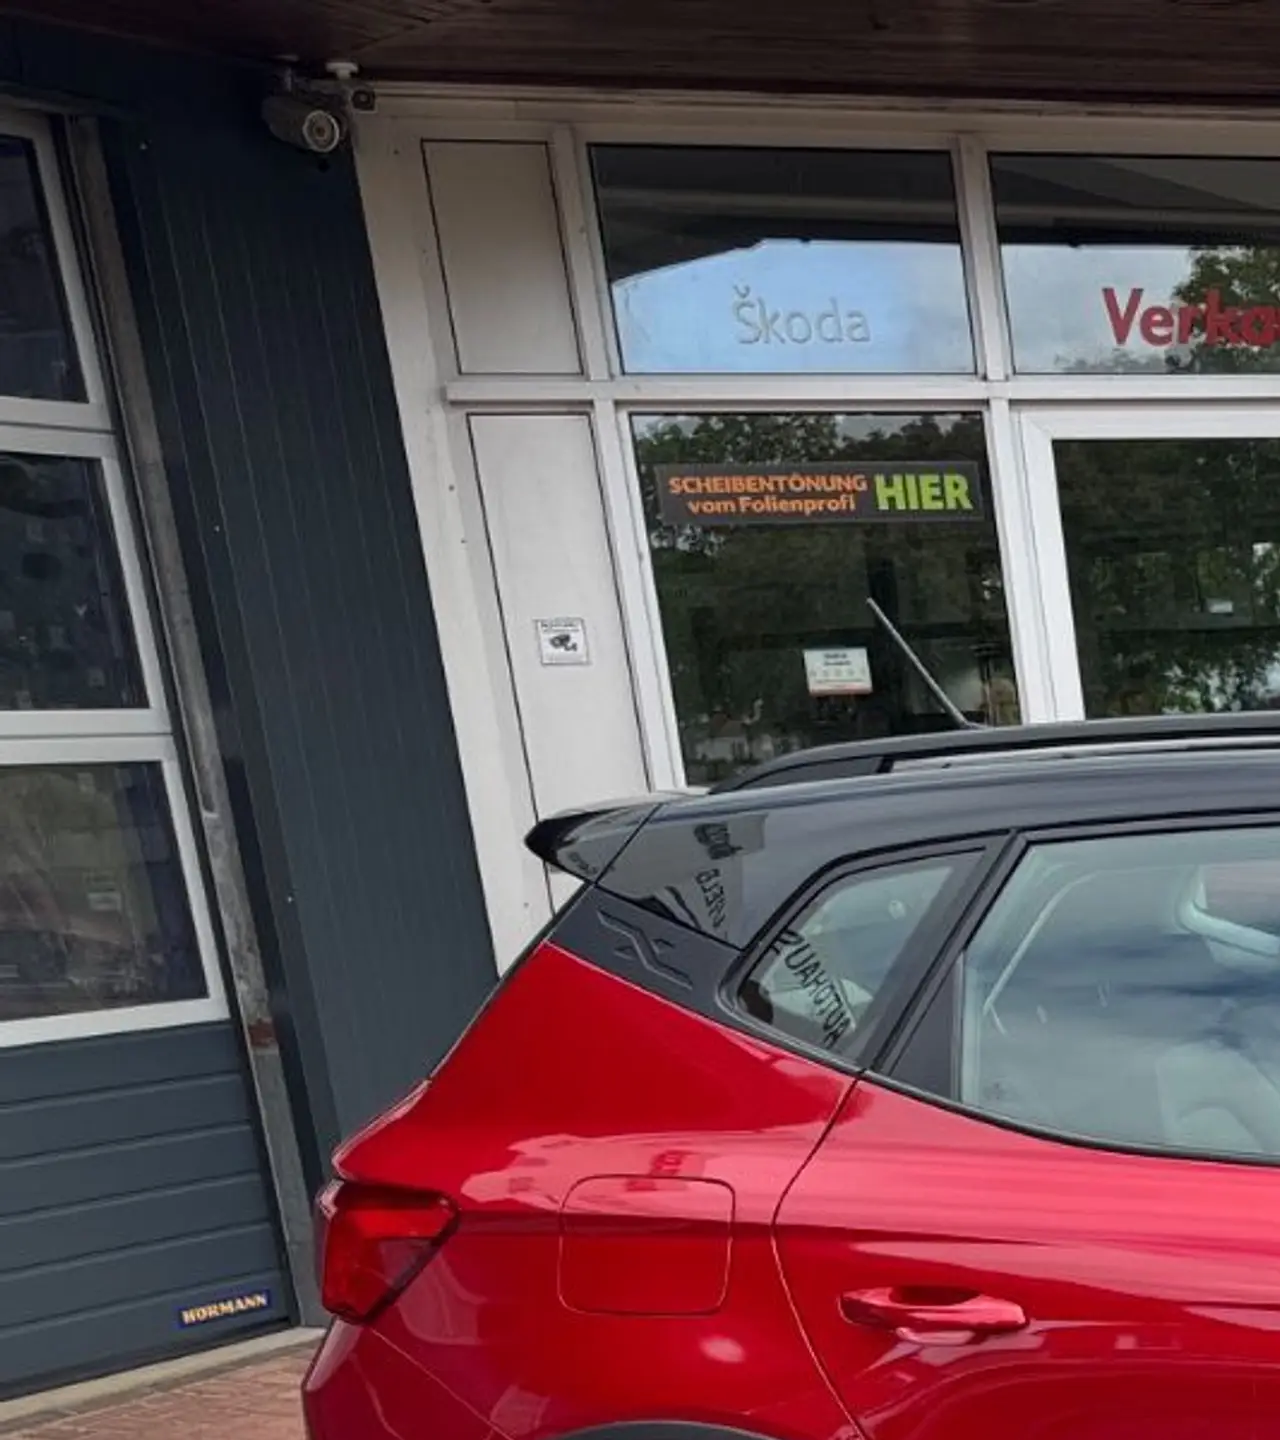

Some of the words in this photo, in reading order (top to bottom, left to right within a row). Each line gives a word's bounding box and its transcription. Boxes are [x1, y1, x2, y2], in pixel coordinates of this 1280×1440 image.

[732, 285, 871, 344] Škoda
[668, 472, 868, 495] SCHEIBENTÖNUNG
[873, 473, 974, 511] HIER
[688, 499, 737, 515] vom
[739, 493, 856, 516] Folienprofi
